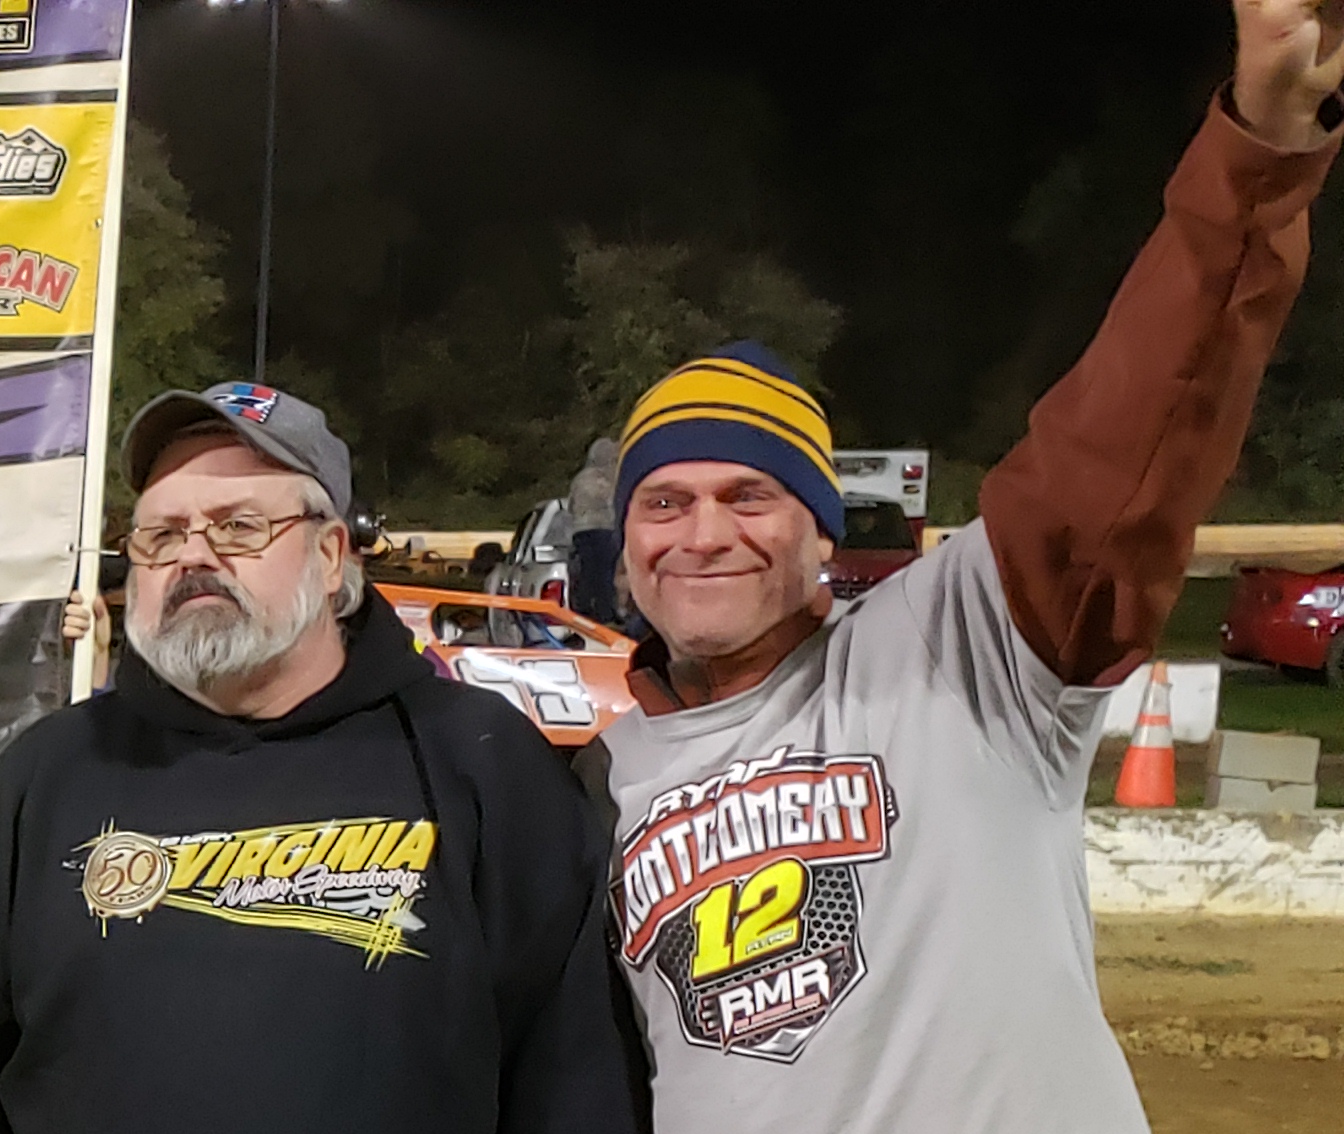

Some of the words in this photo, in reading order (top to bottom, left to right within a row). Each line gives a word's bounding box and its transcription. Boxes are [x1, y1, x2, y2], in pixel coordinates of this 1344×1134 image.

[168, 818, 439, 890] VIRGINIA
[291, 863, 422, 900] Speedway
[691, 857, 810, 983] 12
[719, 957, 832, 1037] RMR
